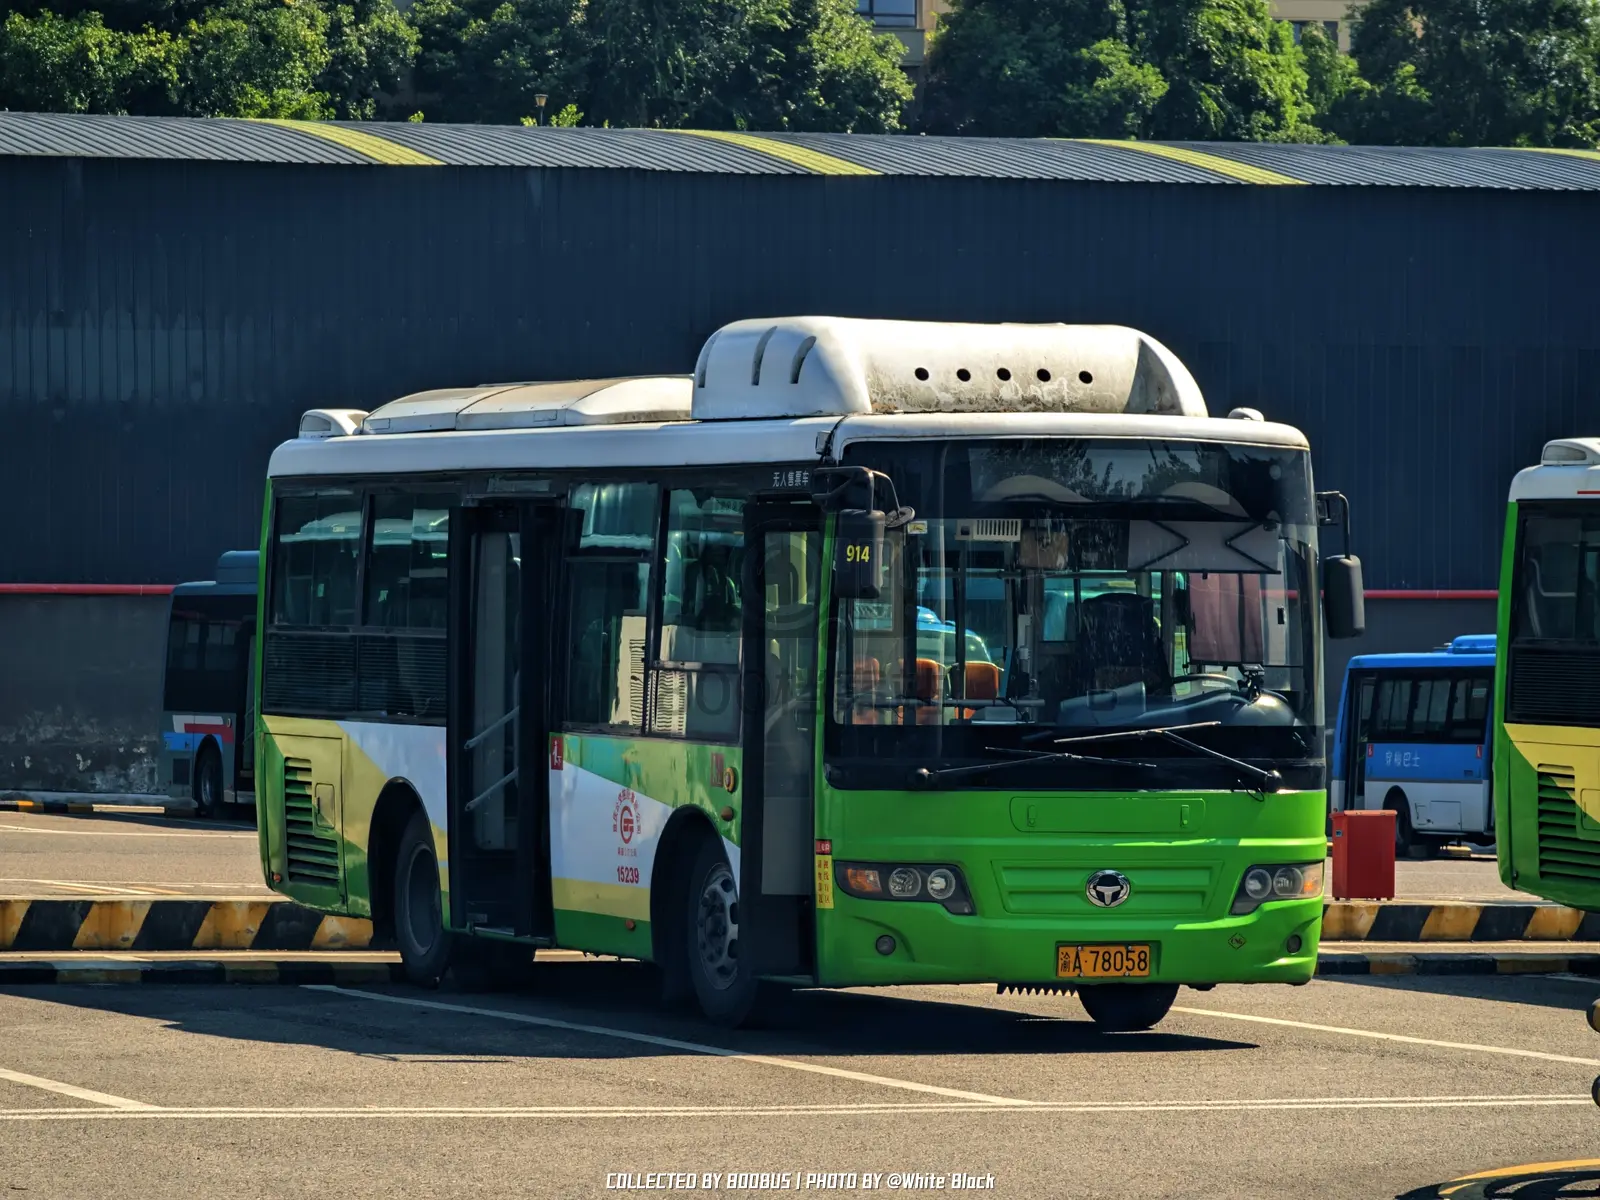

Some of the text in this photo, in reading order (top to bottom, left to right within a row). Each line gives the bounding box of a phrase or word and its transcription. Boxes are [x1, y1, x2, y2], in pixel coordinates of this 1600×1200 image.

[772, 470, 810, 488] 无人售票车
[846, 545, 870, 563] 914
[616, 866, 640, 884] 15239
